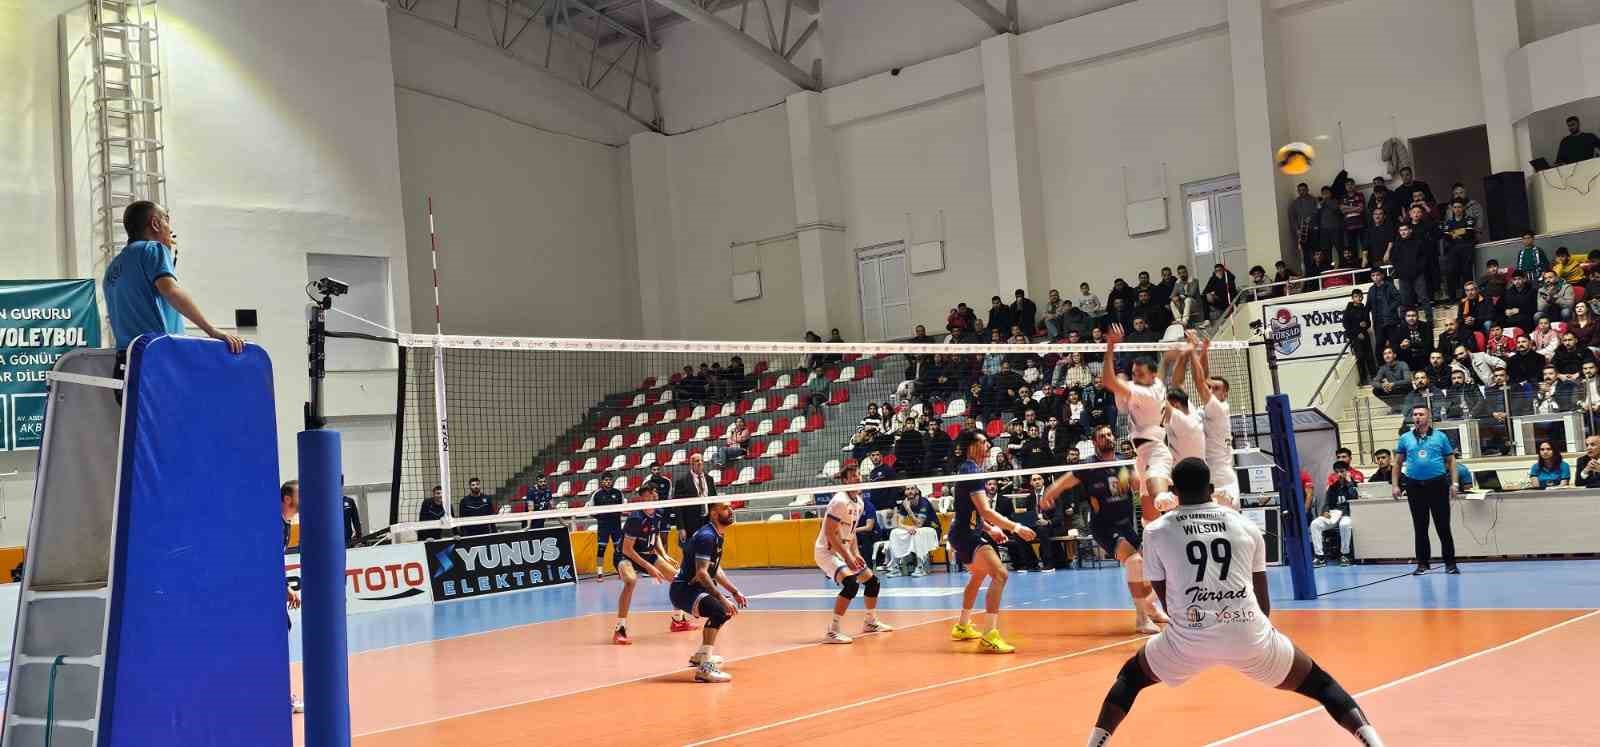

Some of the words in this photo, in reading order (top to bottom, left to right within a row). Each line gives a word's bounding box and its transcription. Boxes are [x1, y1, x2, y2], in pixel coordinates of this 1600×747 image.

[11, 308, 72, 320] GURURU
[0, 327, 87, 347] VOLEYBOL
[17, 369, 48, 382] DİLE
[455, 537, 561, 571] YUNUS
[1186, 538, 1232, 582] 99
[346, 561, 424, 593] TOTO
